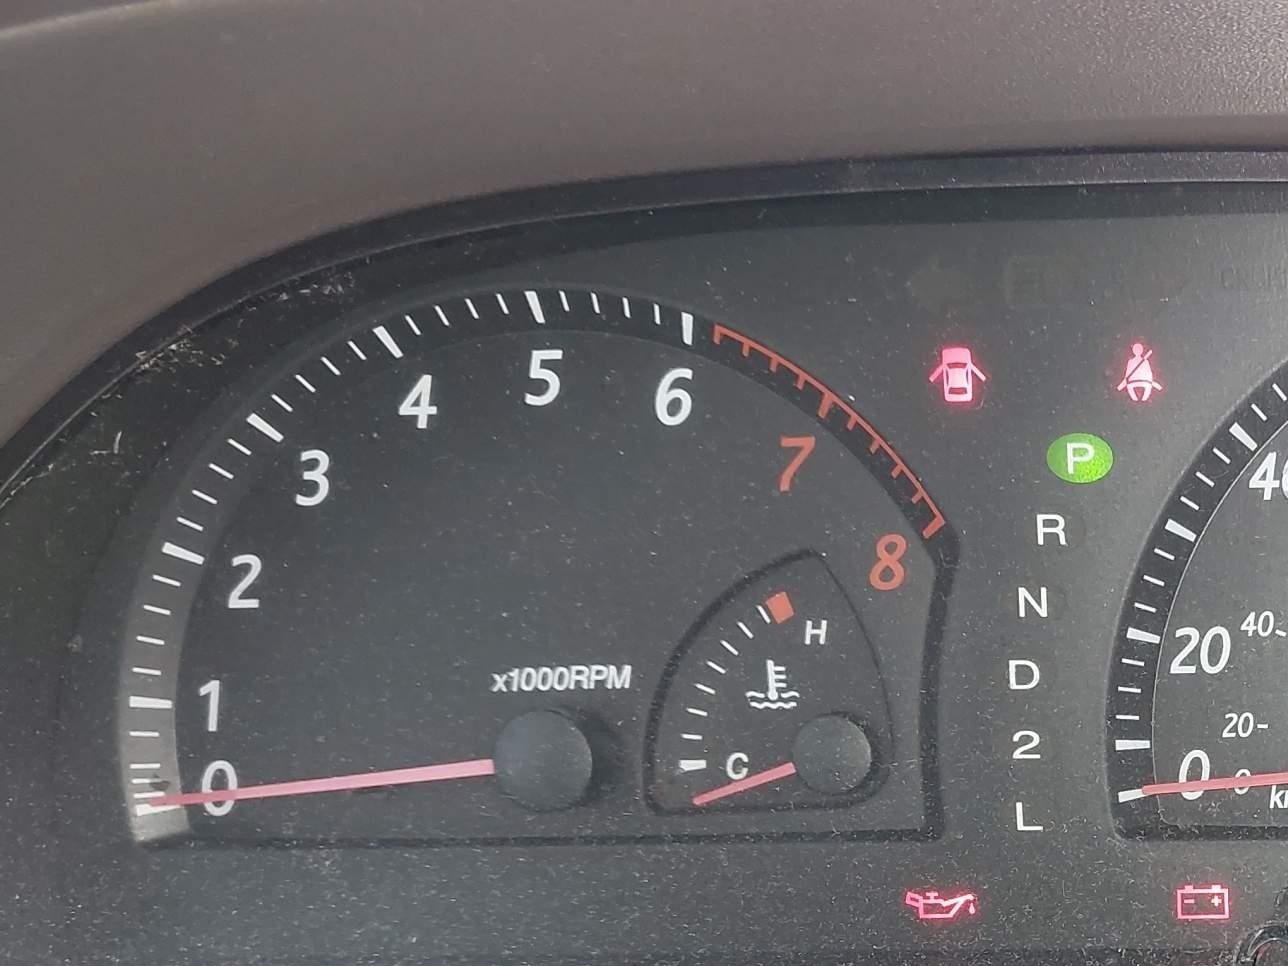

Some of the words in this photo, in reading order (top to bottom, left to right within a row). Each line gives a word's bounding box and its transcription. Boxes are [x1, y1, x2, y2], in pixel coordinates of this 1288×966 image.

[524, 349, 564, 406] 5
[398, 374, 438, 429] 4
[655, 367, 693, 426] 6
[779, 436, 816, 492] 7
[1066, 441, 1096, 475] P
[295, 449, 330, 507] 3
[1036, 513, 1067, 546] R
[869, 533, 907, 591] 8
[227, 554, 262, 609] 2
[1018, 586, 1048, 618] N
[804, 619, 828, 645] H
[1240, 610, 1275, 637] 40
[1169, 625, 1231, 675] 20
[491, 664, 632, 693] x1000RPM
[1008, 659, 1040, 690] D
[199, 679, 220, 732] 1
[1221, 711, 1254, 738] 20
[1012, 730, 1041, 759] 2
[725, 752, 750, 781] C
[1015, 801, 1044, 831] L
